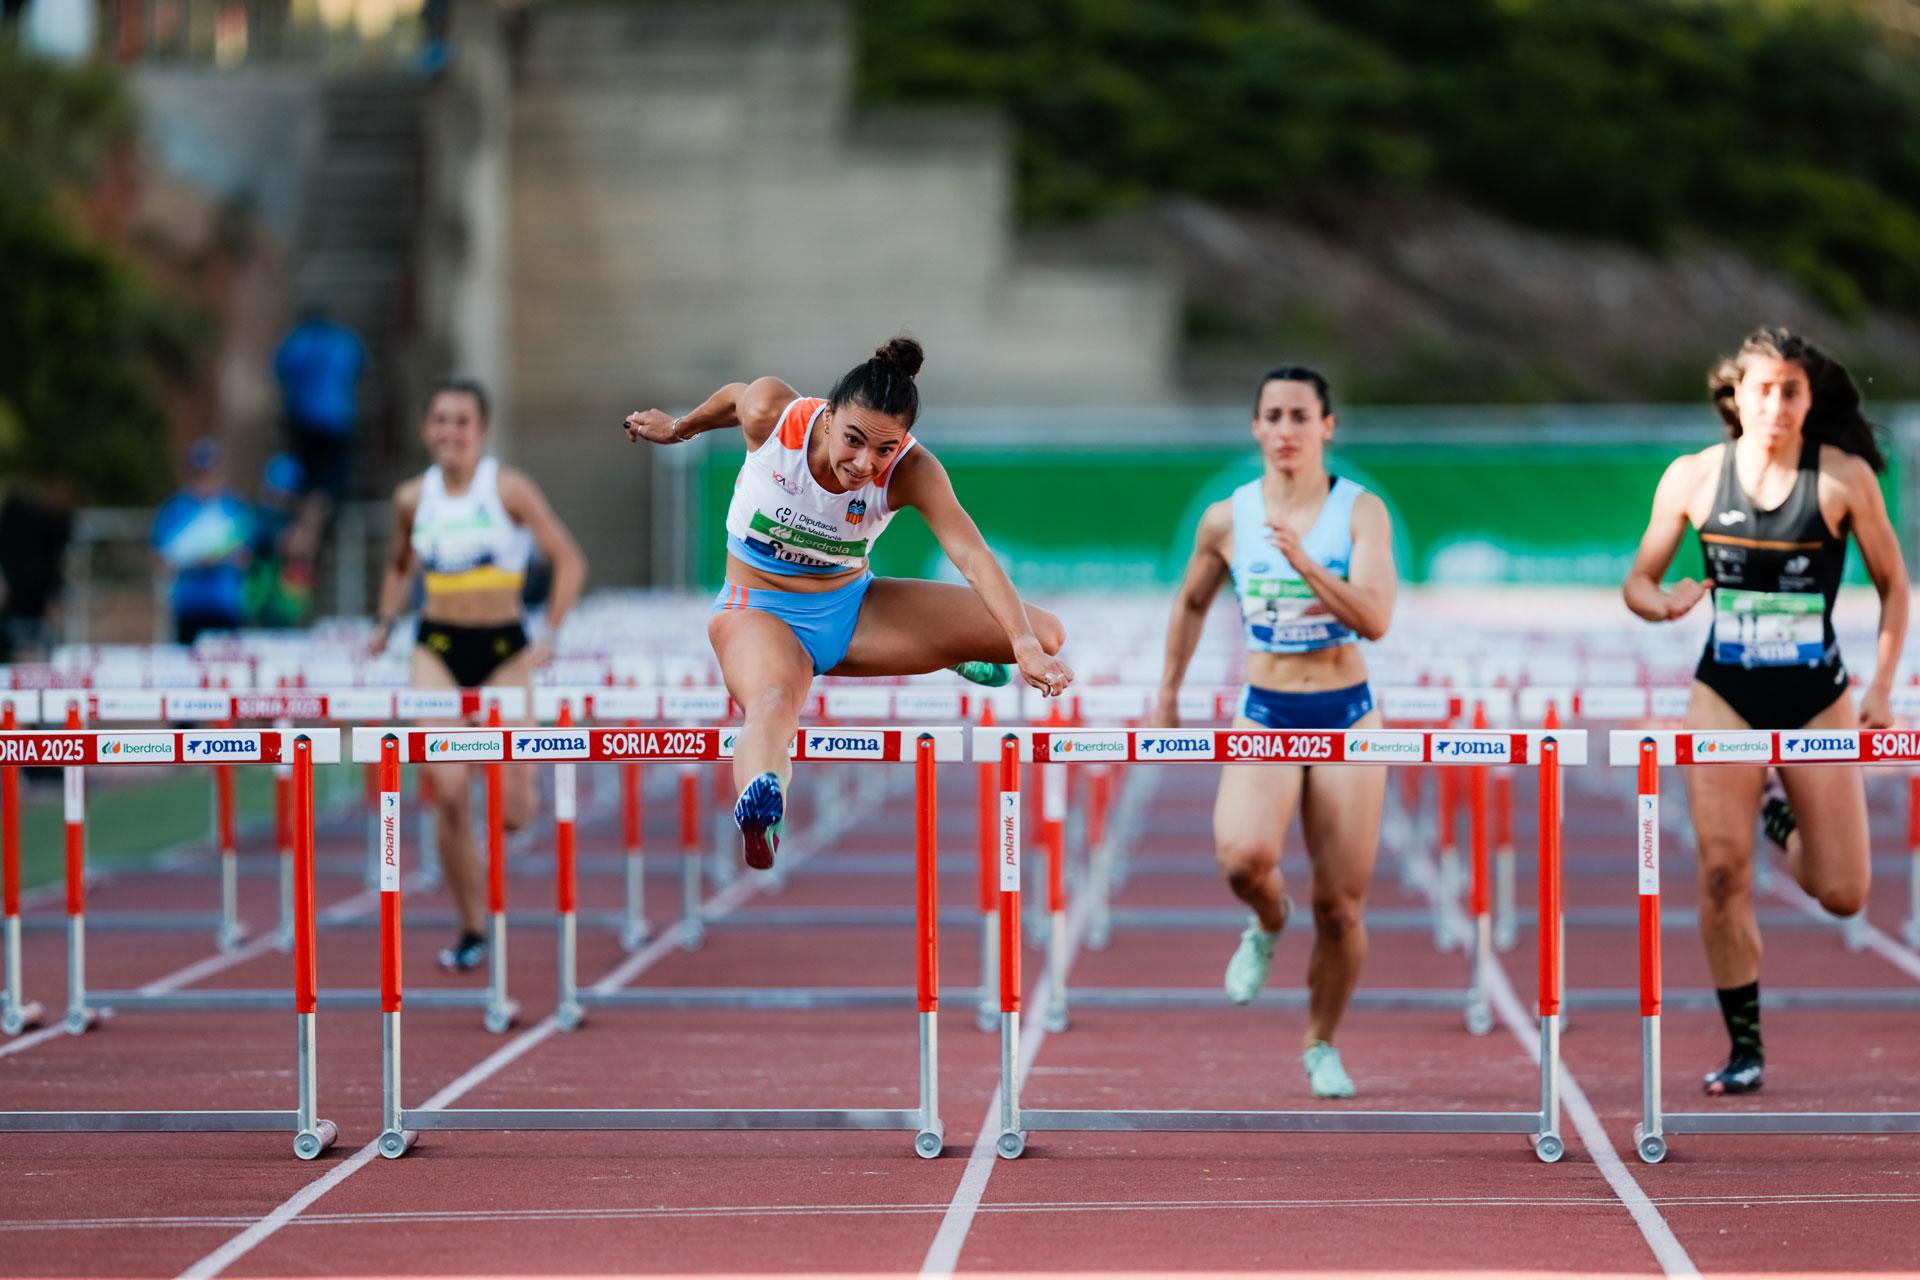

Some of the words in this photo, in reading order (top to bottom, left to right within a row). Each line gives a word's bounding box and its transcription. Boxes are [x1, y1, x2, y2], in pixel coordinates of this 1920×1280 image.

[798, 514, 838, 533] Diputació
[41, 738, 84, 761] 2025
[123, 742, 172, 753] Iberdrola
[451, 740, 500, 752] Iberdrola
[602, 732, 660, 755] SORIA
[663, 732, 706, 755] 2025
[1073, 741, 1124, 752] Iberdrola
[1226, 734, 1284, 757] SORIA
[1287, 735, 1332, 758] 2025
[1371, 742, 1420, 753] Iberdrola
[1719, 741, 1769, 753] Iberdrola
[1871, 733, 1920, 756] SORI
[384, 816, 396, 866] polanik
[1004, 816, 1016, 866] polanik
[1644, 818, 1655, 870] polanik
